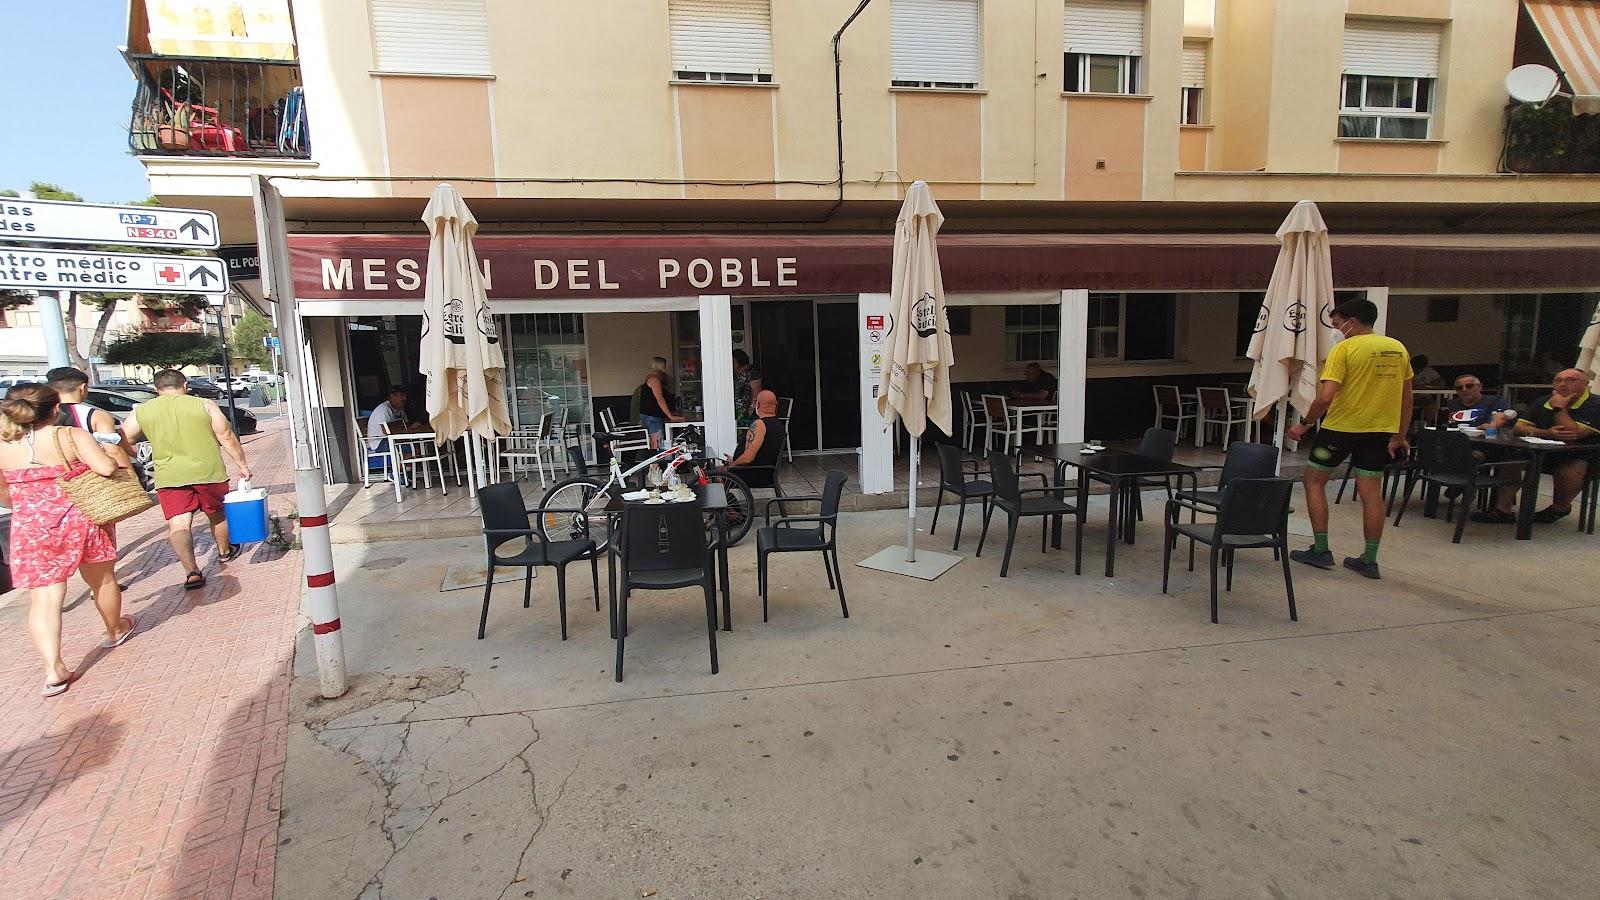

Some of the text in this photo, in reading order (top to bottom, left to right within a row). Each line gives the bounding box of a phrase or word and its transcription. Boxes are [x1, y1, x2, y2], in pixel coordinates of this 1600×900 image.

[121, 214, 156, 225] AP-7
[128, 228, 177, 239] N-340
[57, 257, 141, 271] médico
[230, 258, 241, 269] EL
[321, 257, 798, 291] MESN DEL POBLE
